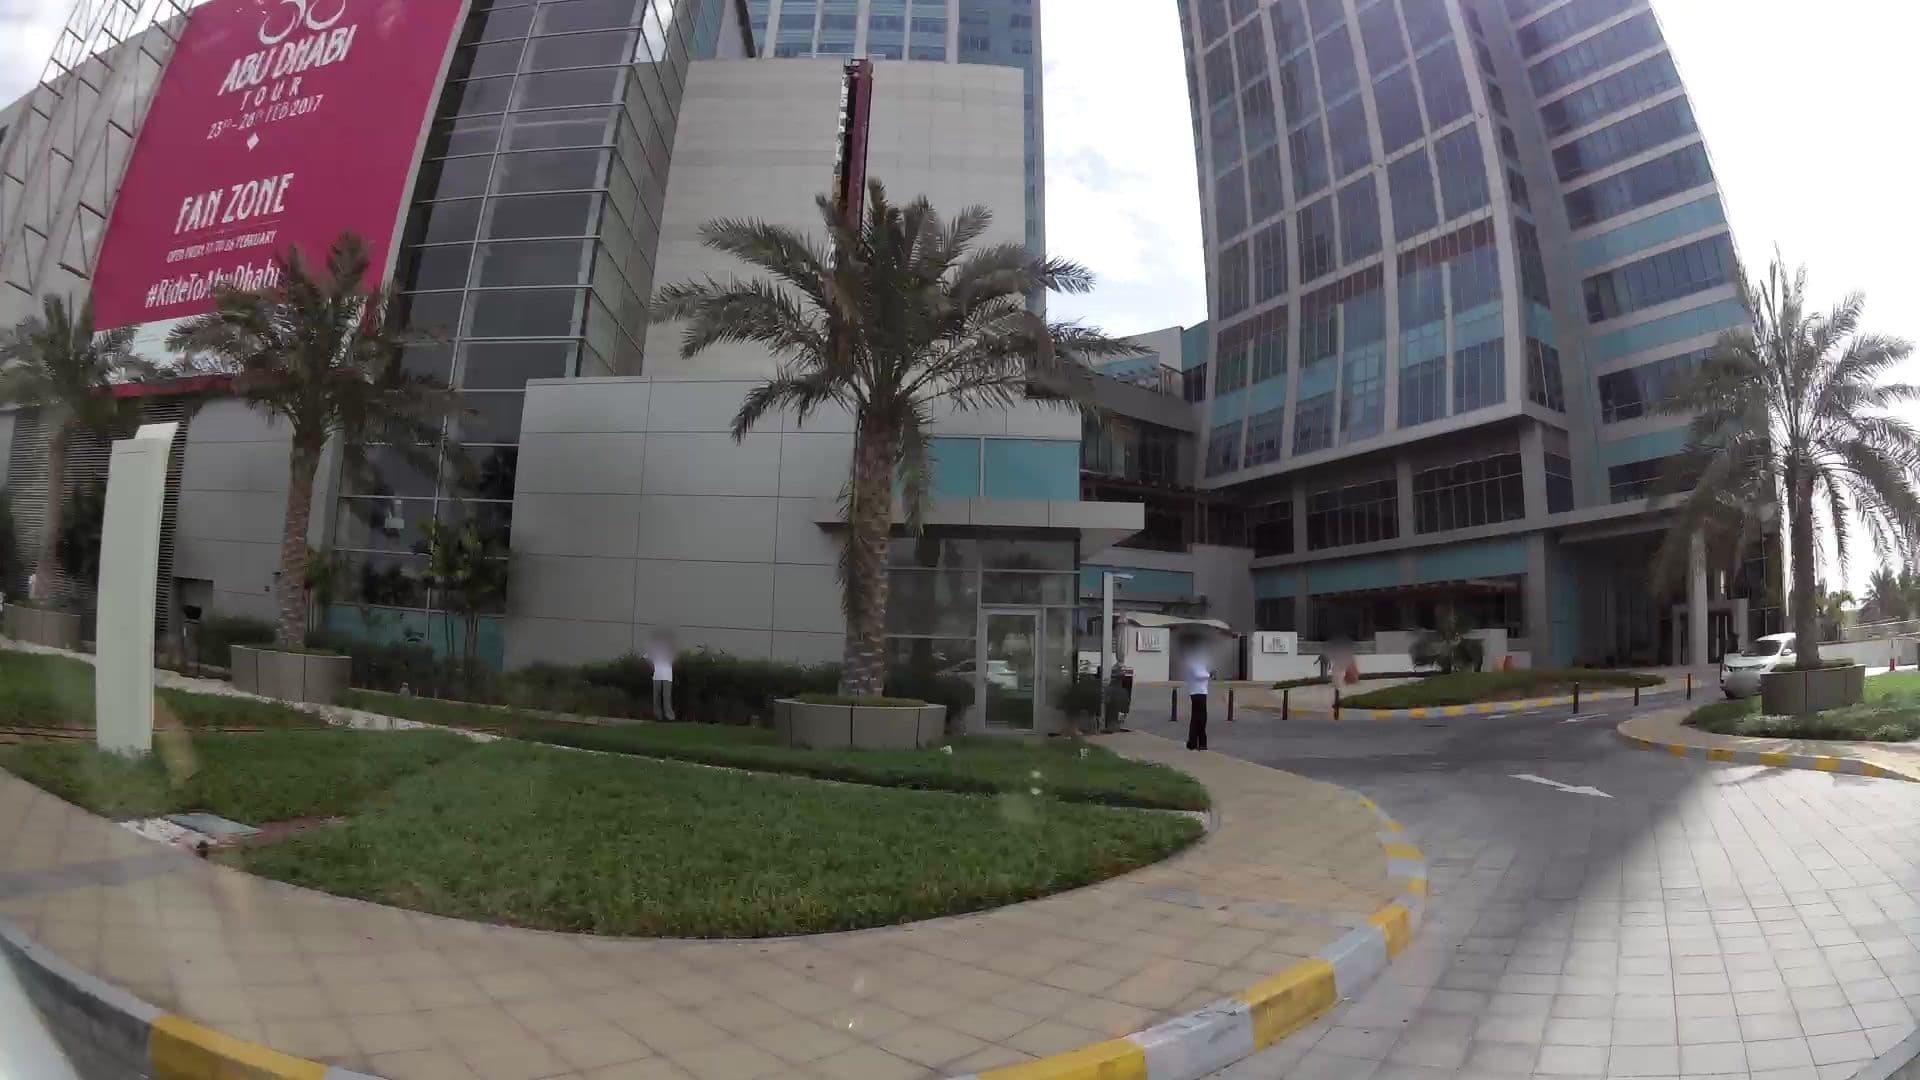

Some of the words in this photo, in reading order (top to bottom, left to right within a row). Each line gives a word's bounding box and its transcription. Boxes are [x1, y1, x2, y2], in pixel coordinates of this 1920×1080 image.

[217, 47, 278, 96] ABU
[271, 24, 358, 79] DHABI
[240, 77, 302, 111] TOUR
[289, 94, 324, 117] 2017
[174, 188, 224, 235] FAN
[221, 172, 294, 223] ZONE
[236, 230, 277, 249] FEBRUARY
